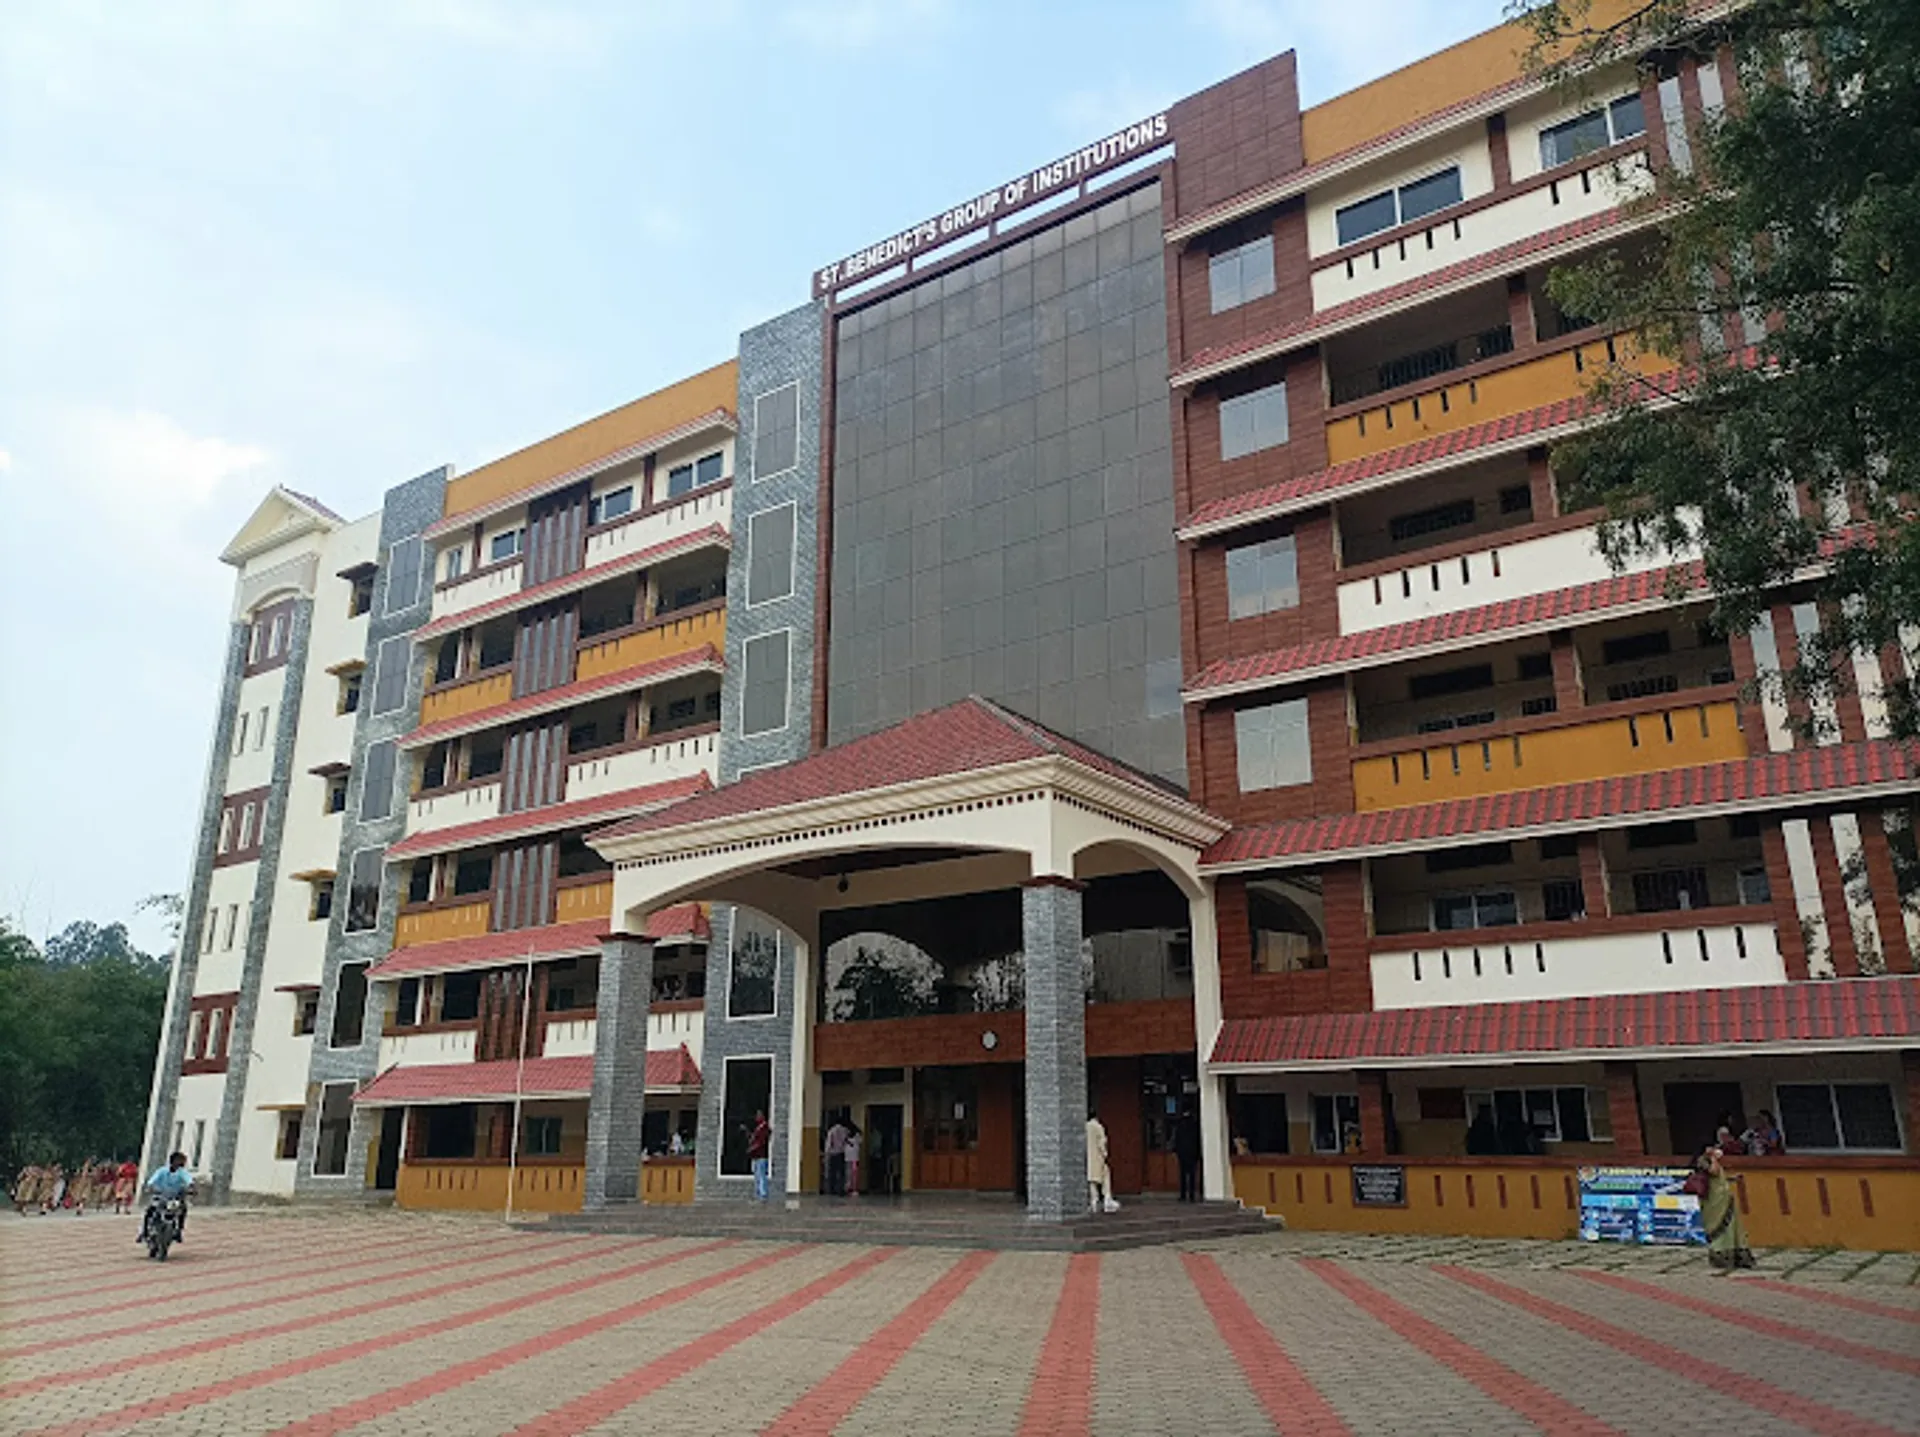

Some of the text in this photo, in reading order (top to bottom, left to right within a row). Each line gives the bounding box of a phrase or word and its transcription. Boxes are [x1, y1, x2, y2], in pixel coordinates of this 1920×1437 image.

[820, 115, 1168, 289] ST. BENEDICT'S GROUP OF INSTITUTIONS
